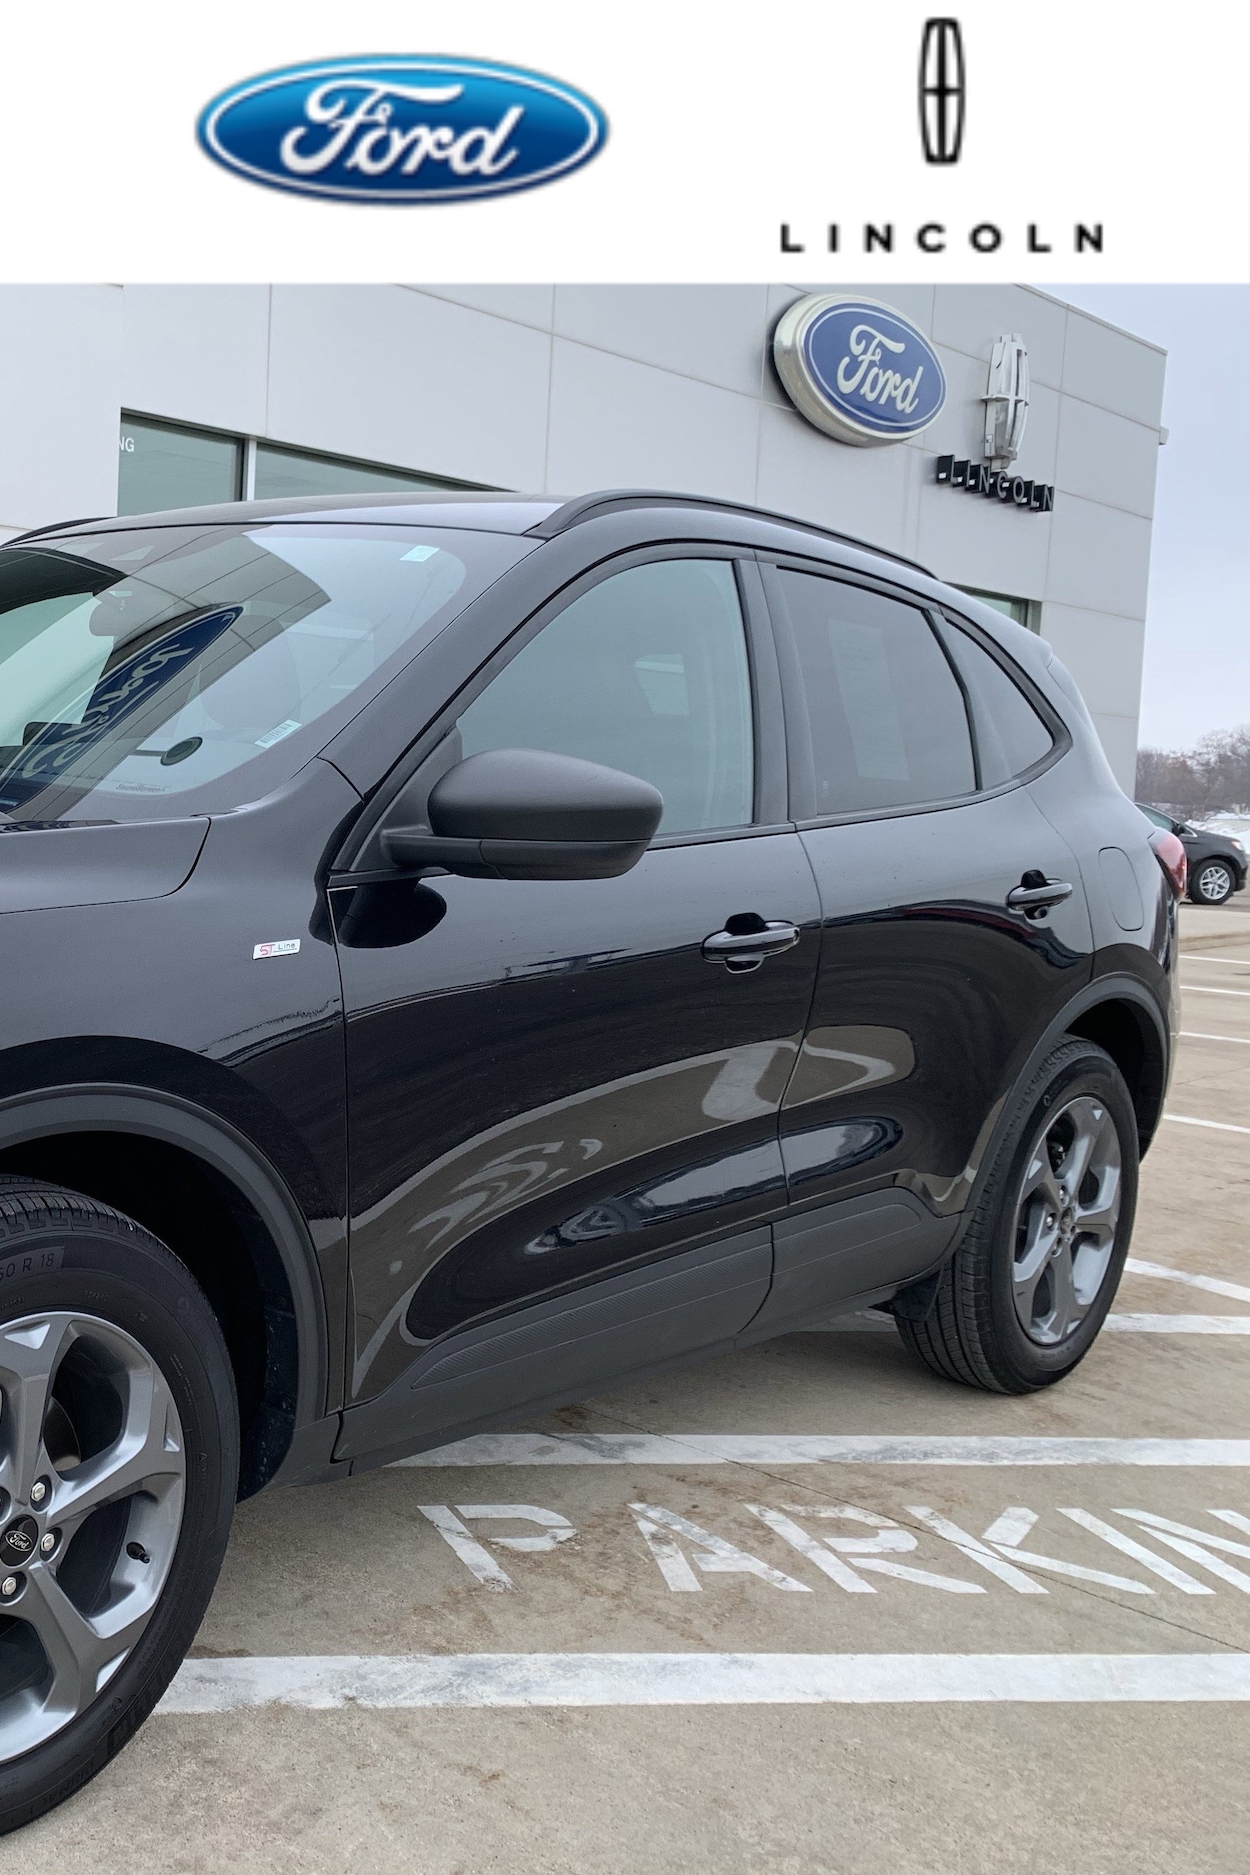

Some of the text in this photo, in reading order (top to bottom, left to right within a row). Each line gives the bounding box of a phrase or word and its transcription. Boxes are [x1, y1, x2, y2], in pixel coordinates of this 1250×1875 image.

[837, 324, 923, 415] Ford
[937, 455, 1055, 512] LINCOLN
[22, 1257, 33, 1273] R
[40, 1252, 55, 1268] 18
[9, 1533, 30, 1549] Ford
